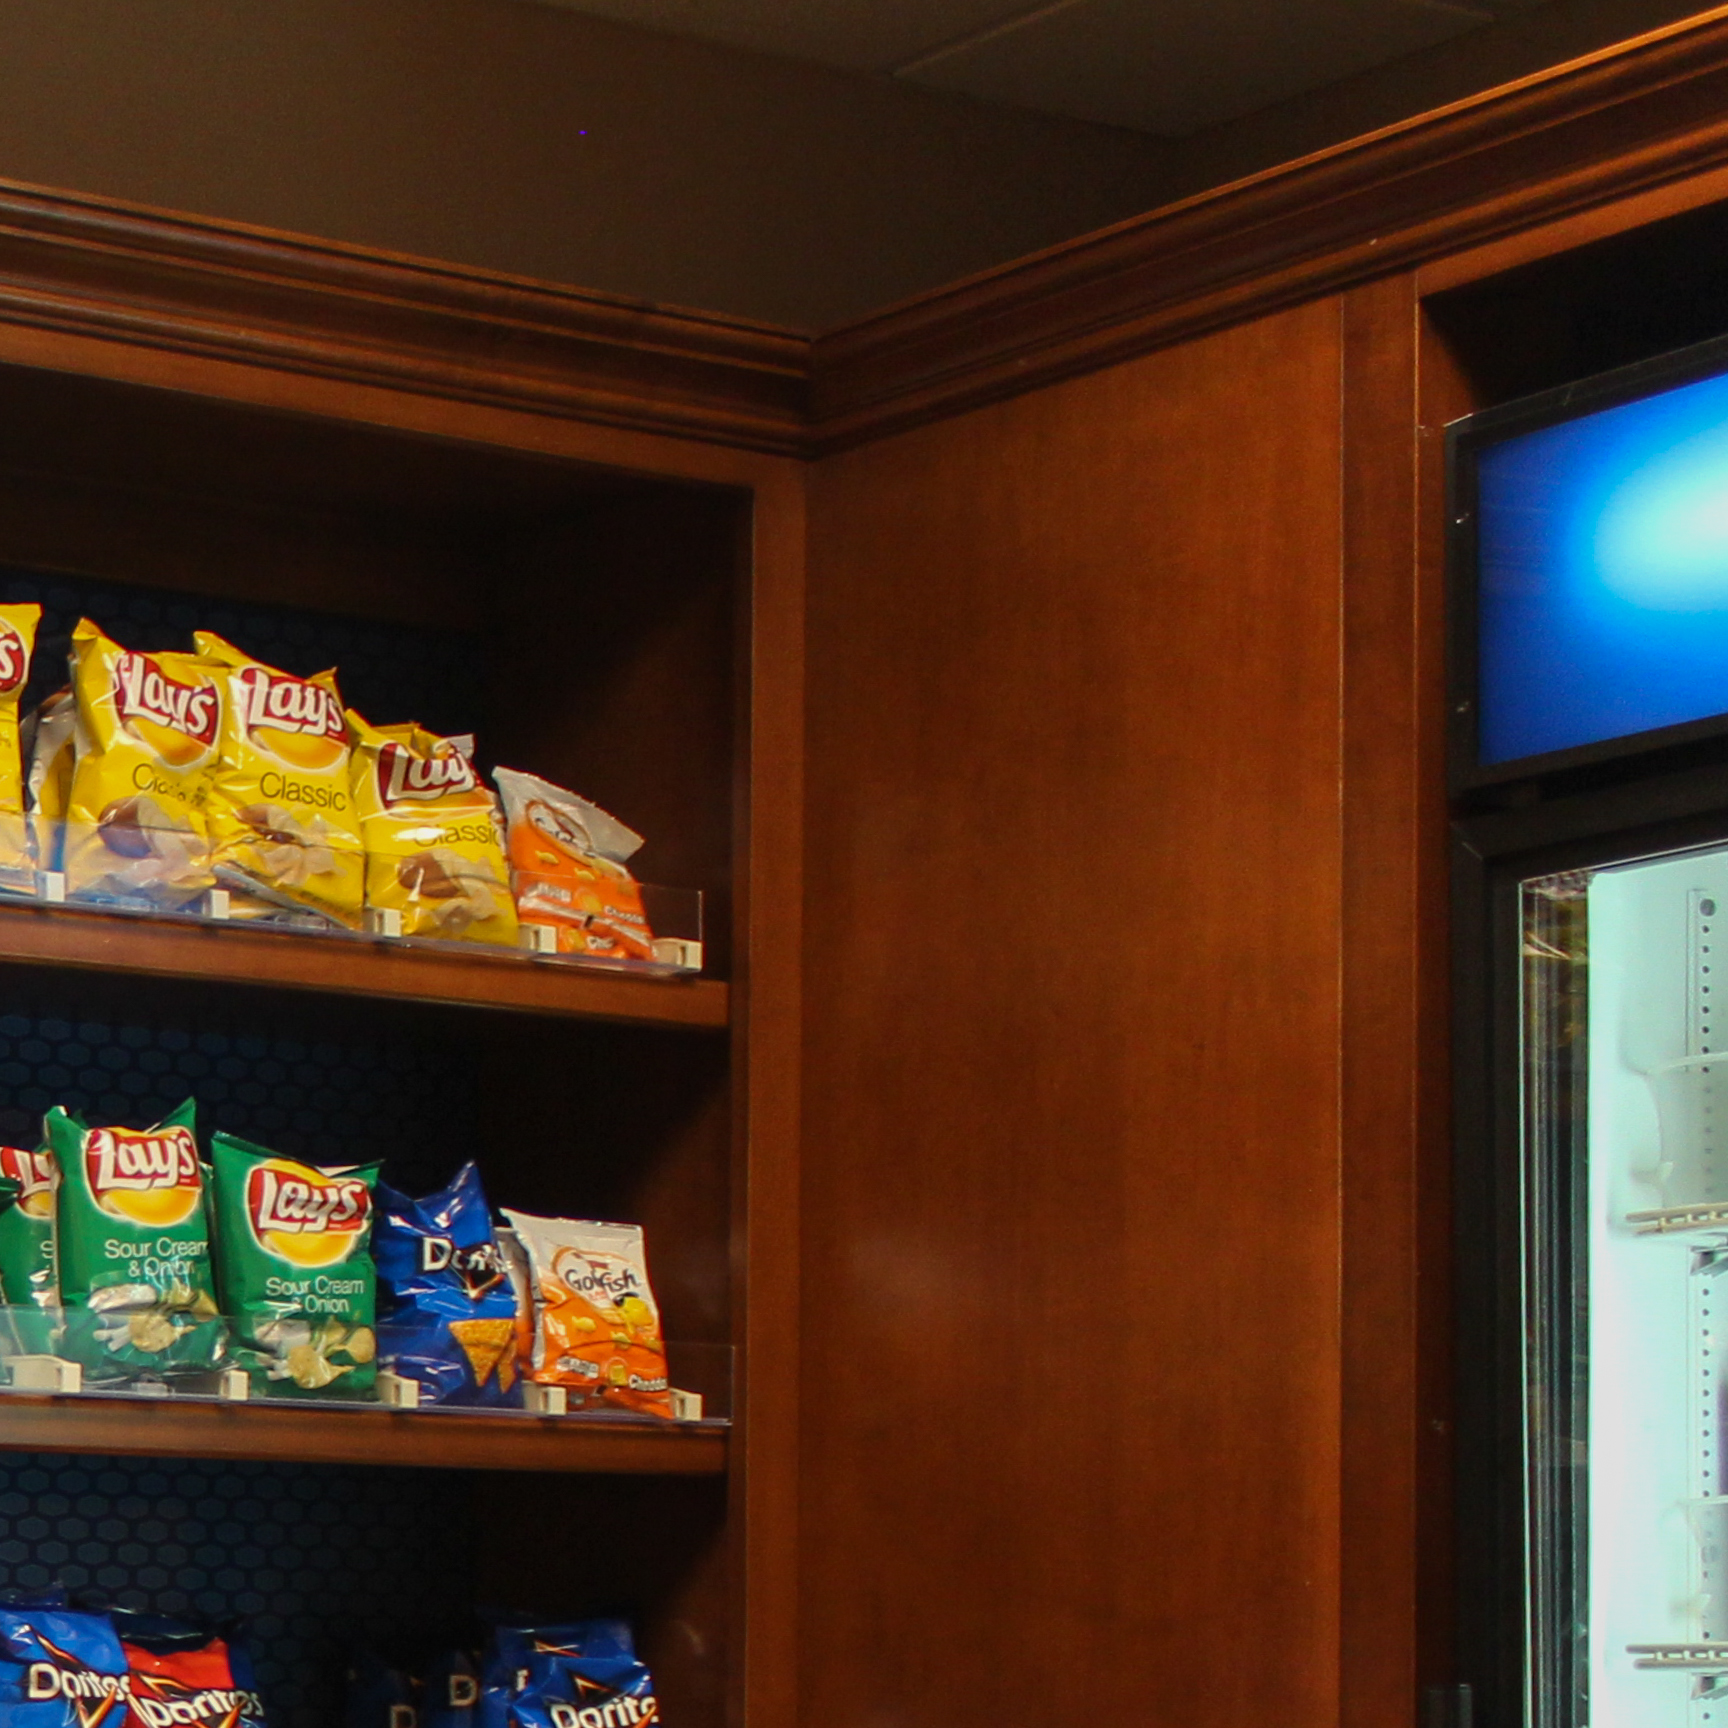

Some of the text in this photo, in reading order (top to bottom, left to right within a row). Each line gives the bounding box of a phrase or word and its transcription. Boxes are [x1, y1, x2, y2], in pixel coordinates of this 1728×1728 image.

[123, 652, 217, 735] Lay's
[260, 771, 347, 811] Classic
[95, 1129, 195, 1190] Lay's
[259, 1170, 363, 1232] Lay's
[104, 1239, 150, 1260] Sour
[128, 1261, 140, 1278] &
[265, 1276, 364, 1297] Sour Cream
[304, 1297, 349, 1314] Onion
[28, 1661, 131, 1701] Doritos
